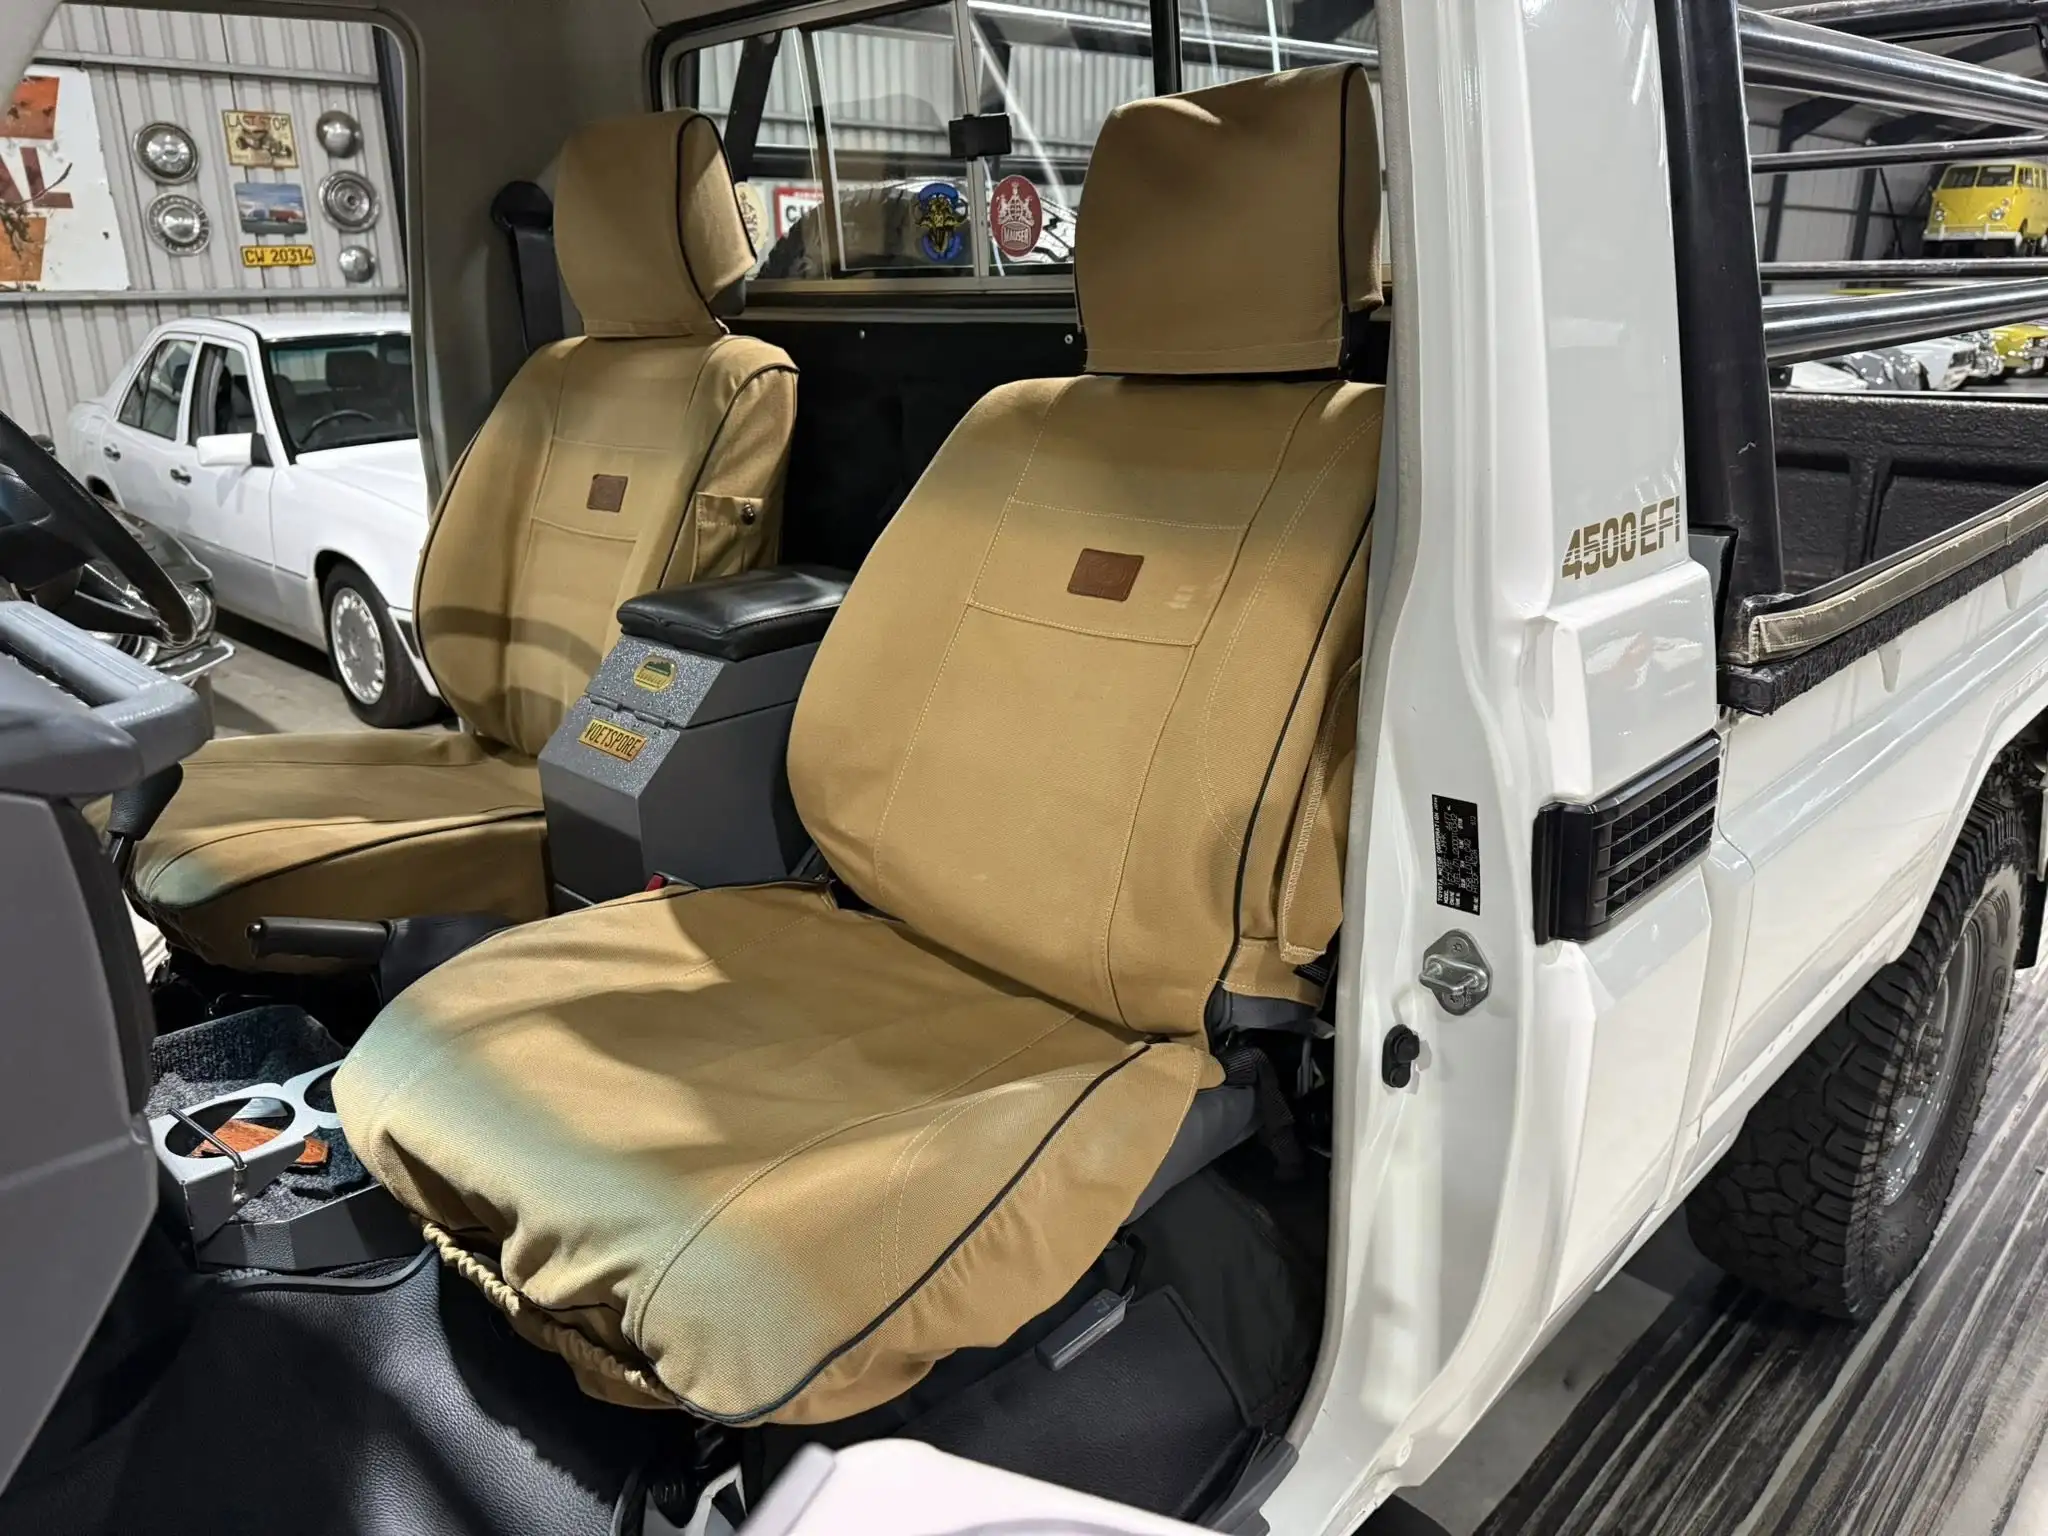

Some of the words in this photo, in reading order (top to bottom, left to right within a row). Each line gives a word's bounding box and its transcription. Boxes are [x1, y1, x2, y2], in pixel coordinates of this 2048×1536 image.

[227, 114, 256, 129] LAST
[258, 116, 288, 131] STOP
[244, 249, 265, 264] CW
[270, 248, 313, 264] 20314
[584, 721, 643, 758] VOETSPORE
